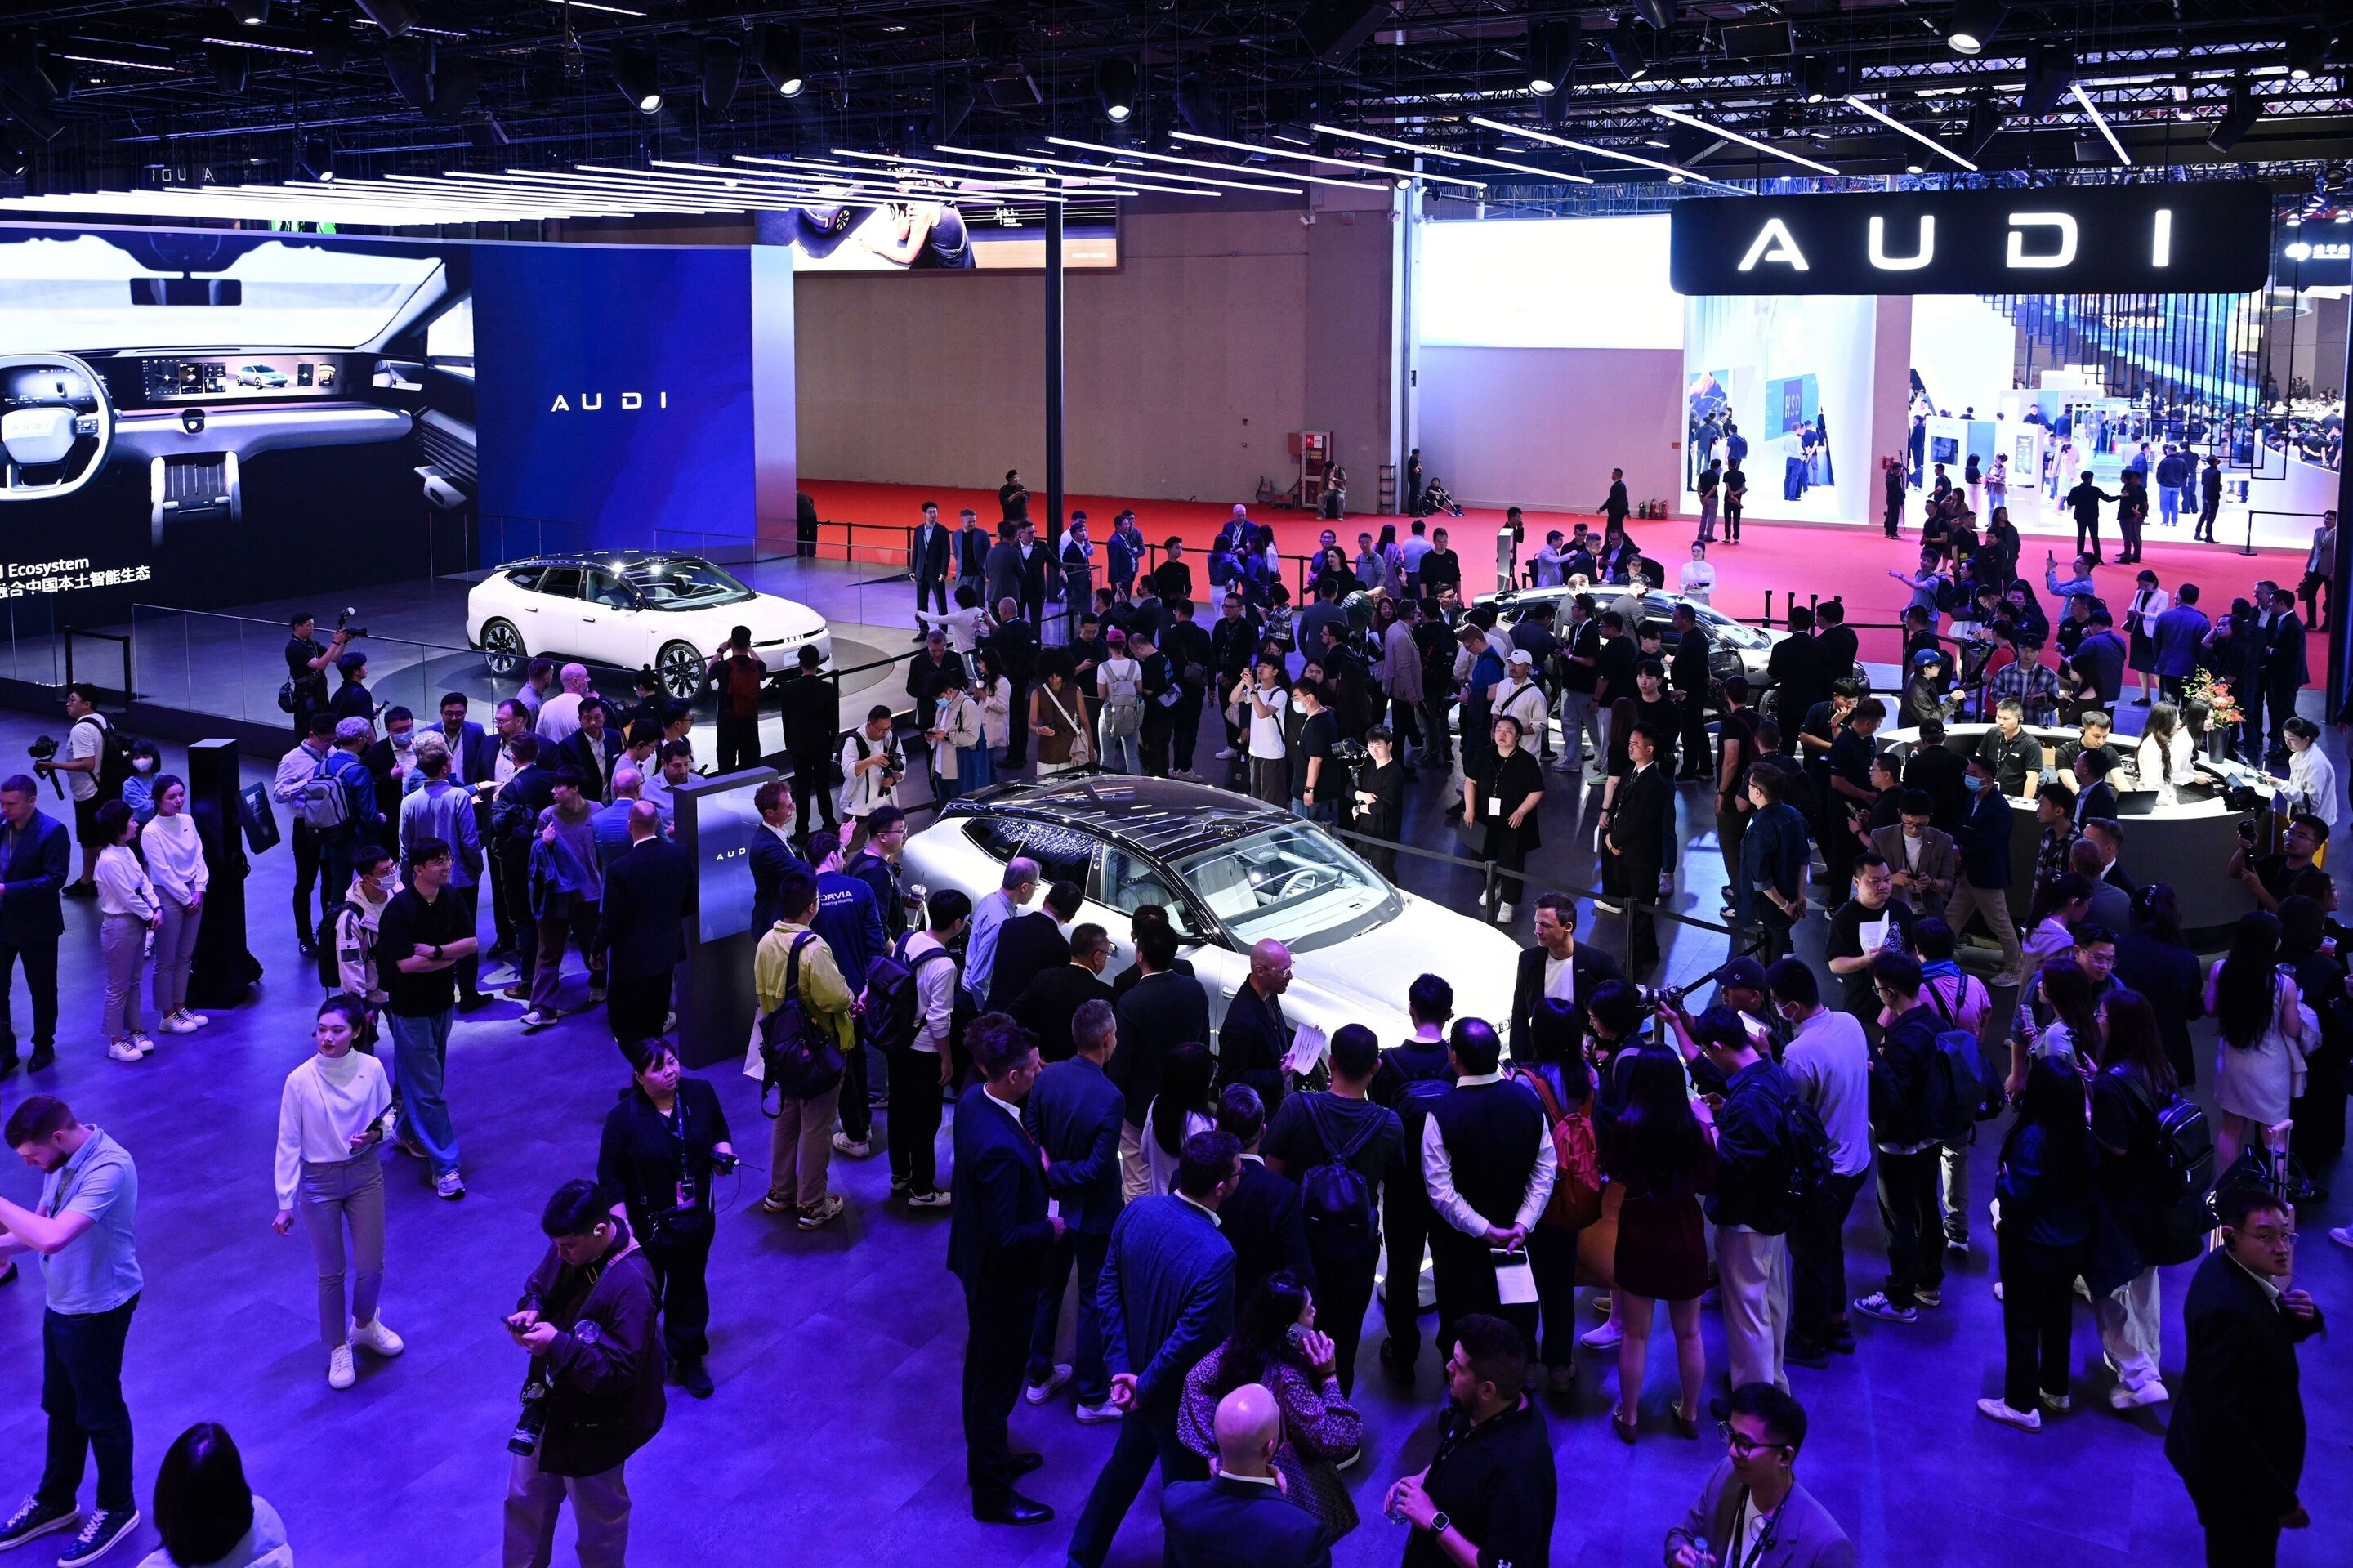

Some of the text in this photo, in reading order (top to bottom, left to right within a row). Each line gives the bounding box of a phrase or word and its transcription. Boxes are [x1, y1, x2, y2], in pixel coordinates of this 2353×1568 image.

[1738, 209, 2172, 272] AUDI
[551, 391, 668, 412] AUDI
[1784, 394, 1801, 419] HSD
[8, 558, 89, 578] Ecosystem
[716, 847, 746, 861] AUD
[819, 891, 853, 901] ORVIA
